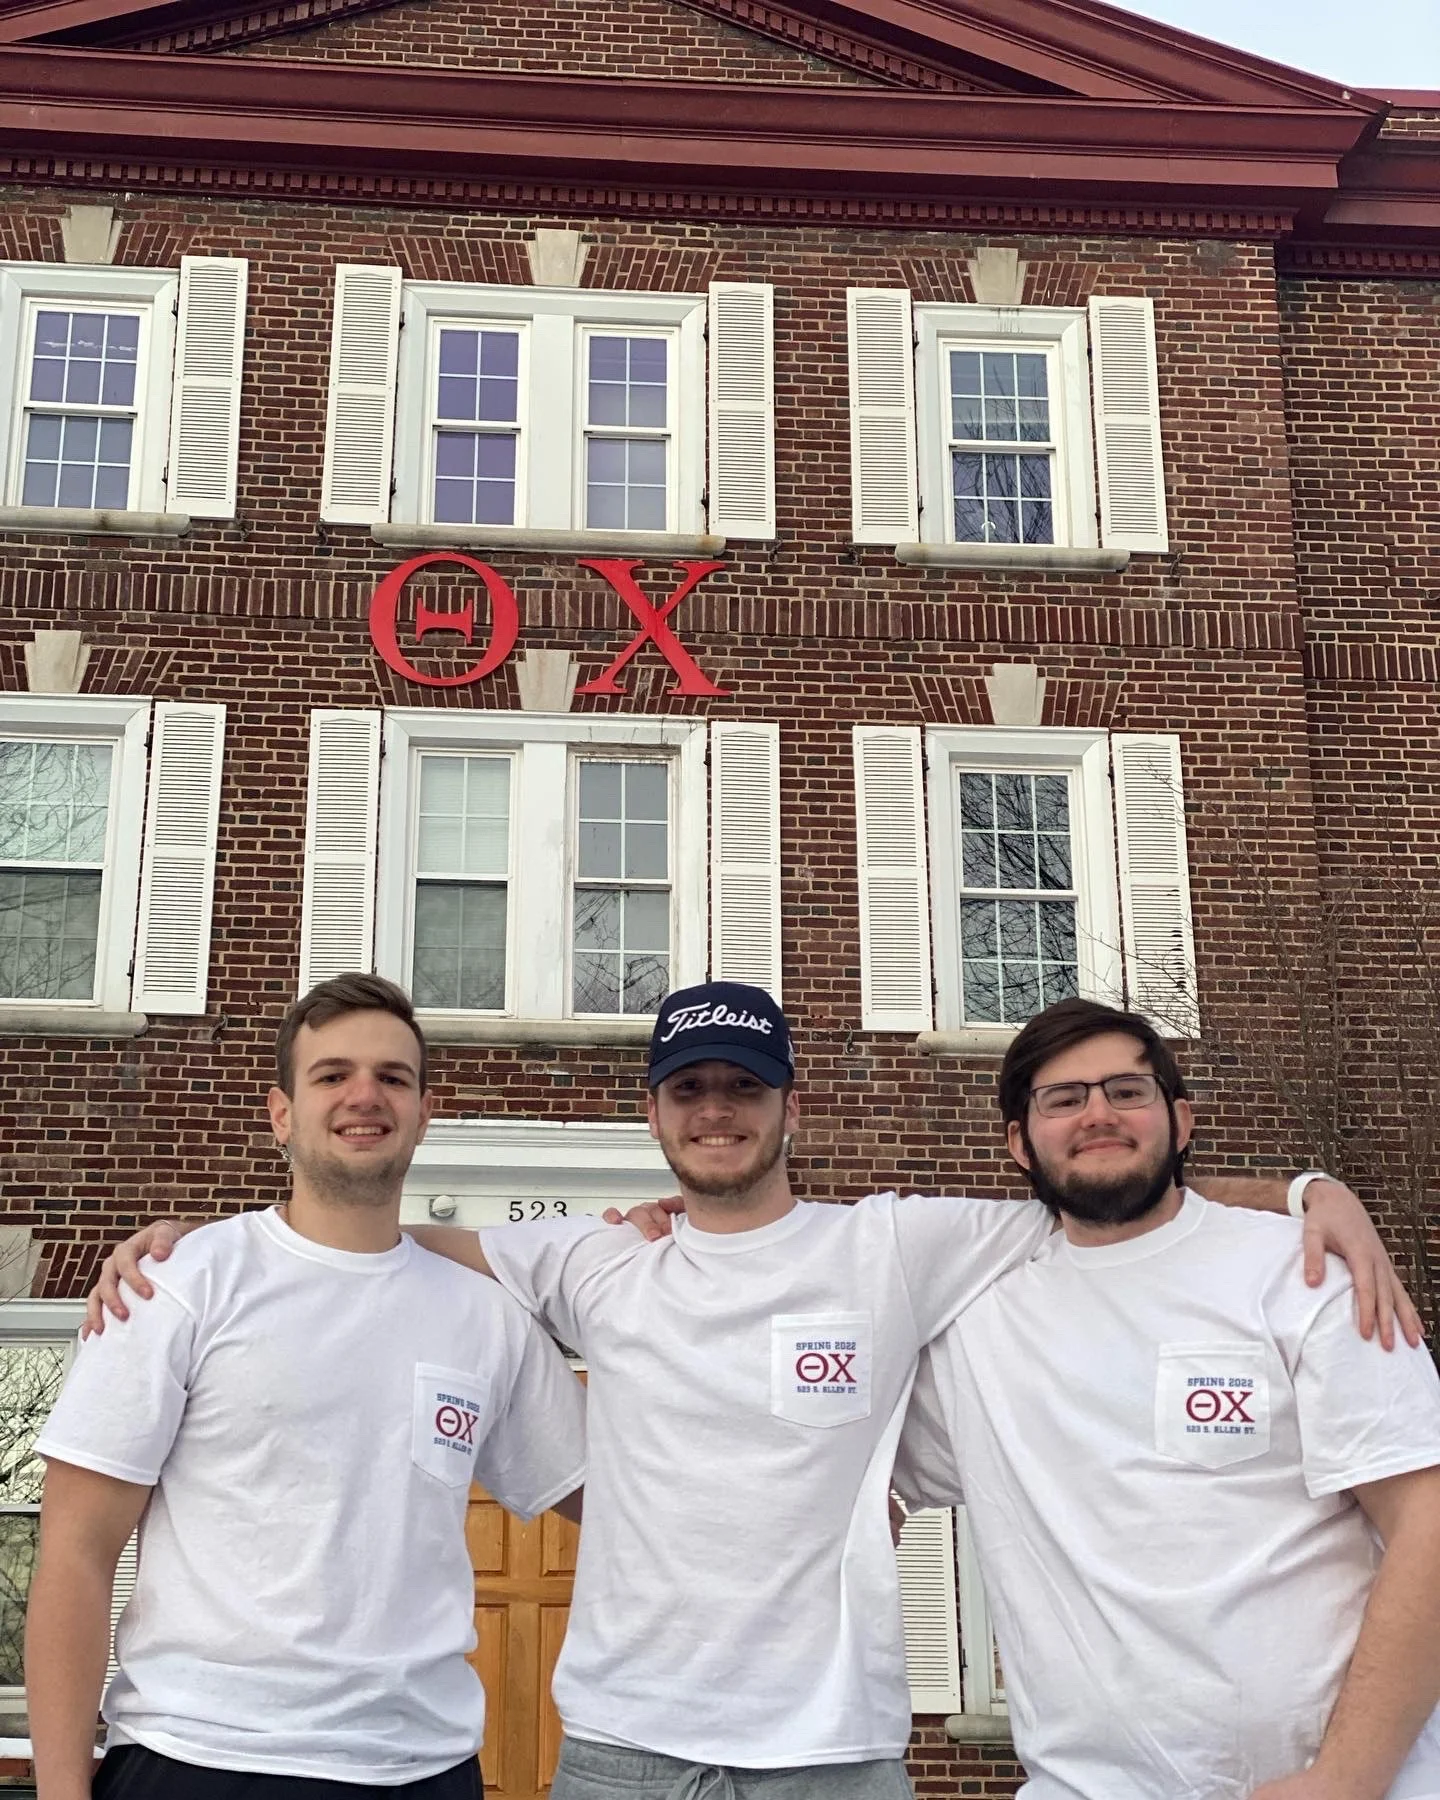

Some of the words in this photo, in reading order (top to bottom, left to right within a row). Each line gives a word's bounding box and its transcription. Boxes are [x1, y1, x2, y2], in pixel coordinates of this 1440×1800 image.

[661, 1002, 773, 1042] Titleist
[509, 1201, 568, 1222] 523
[796, 1341, 831, 1350] SPRING
[835, 1341, 856, 1350] 2022
[1187, 1377, 1225, 1387] SPRING
[1228, 1378, 1254, 1388] 2022
[1186, 1425, 1201, 1433] 523
[1214, 1425, 1242, 1434] ALLEN
